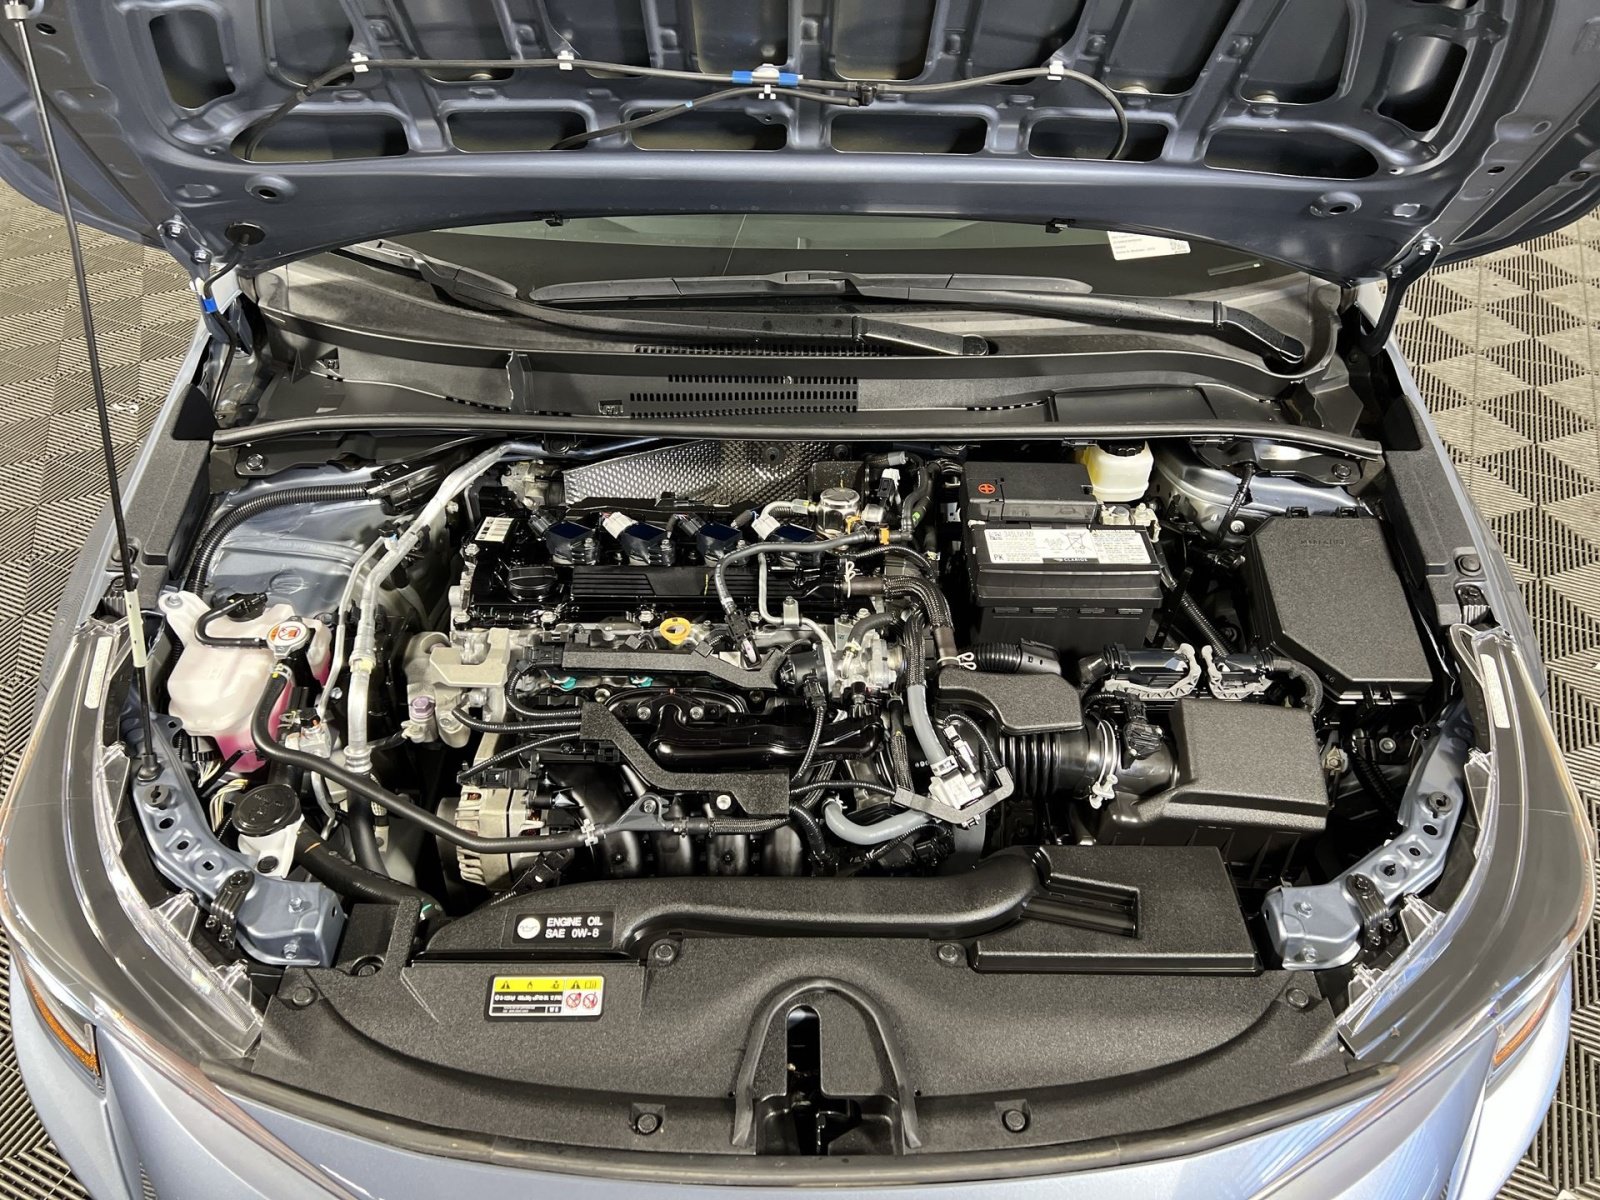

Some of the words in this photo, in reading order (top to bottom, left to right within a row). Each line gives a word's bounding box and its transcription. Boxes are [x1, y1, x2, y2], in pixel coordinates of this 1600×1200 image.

[546, 916, 582, 927] ENGINE
[587, 915, 603, 926] OIL
[545, 928, 566, 939] SAE
